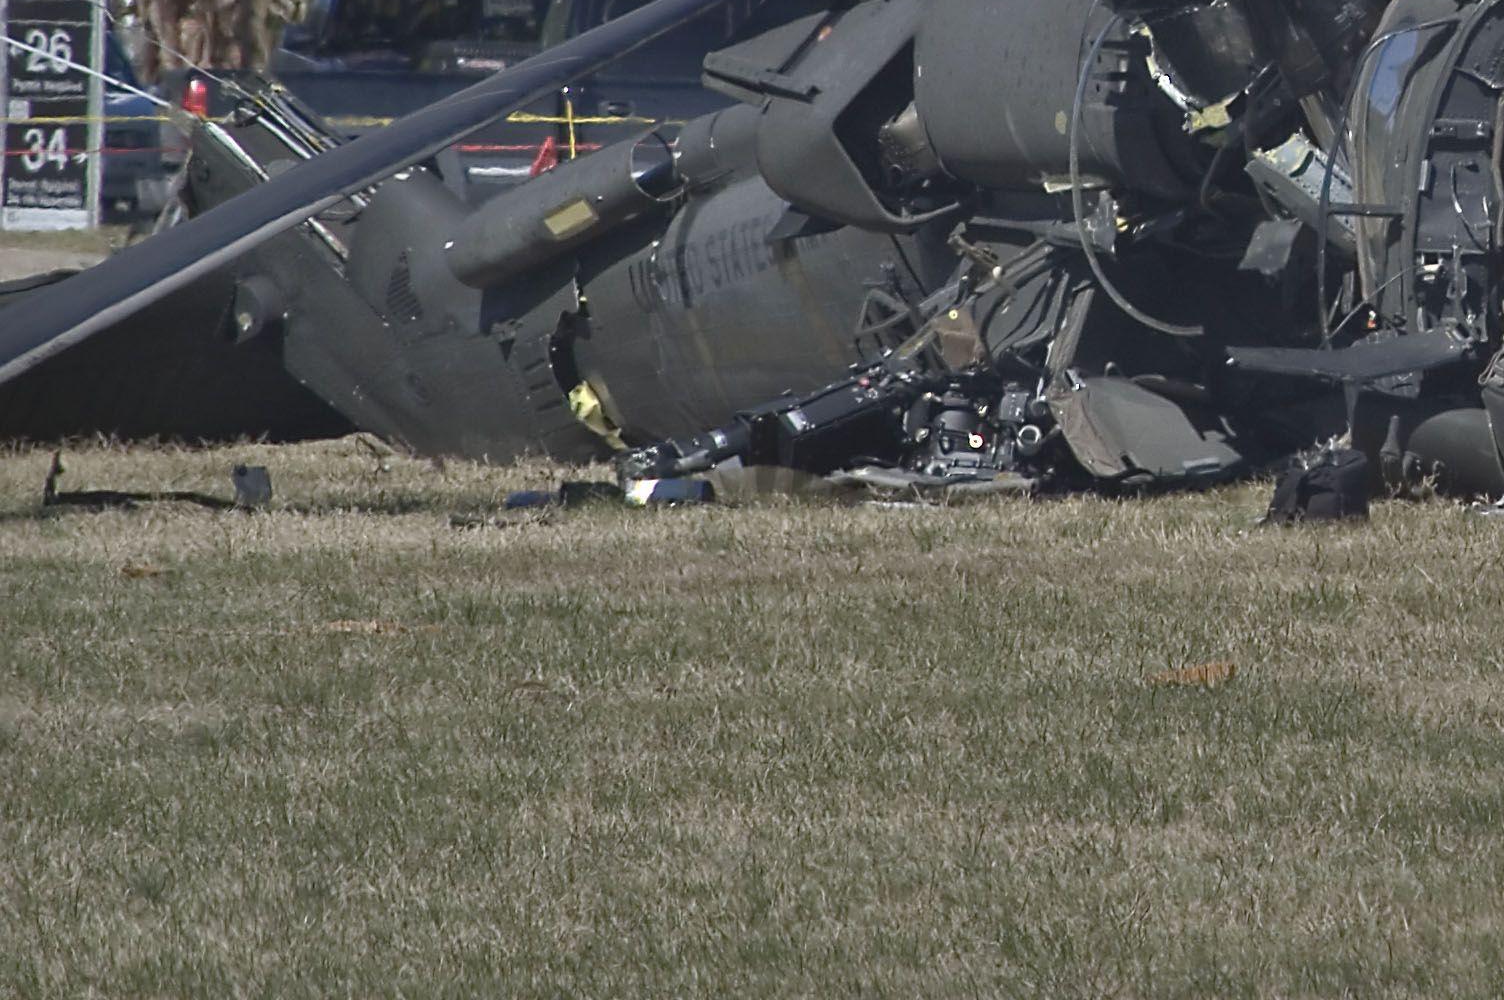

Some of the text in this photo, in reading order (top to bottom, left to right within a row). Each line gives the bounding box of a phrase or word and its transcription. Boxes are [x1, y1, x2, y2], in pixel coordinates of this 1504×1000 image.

[25, 29, 71, 73] 26
[22, 128, 67, 172] 34
[628, 215, 774, 314] UITD STATE
